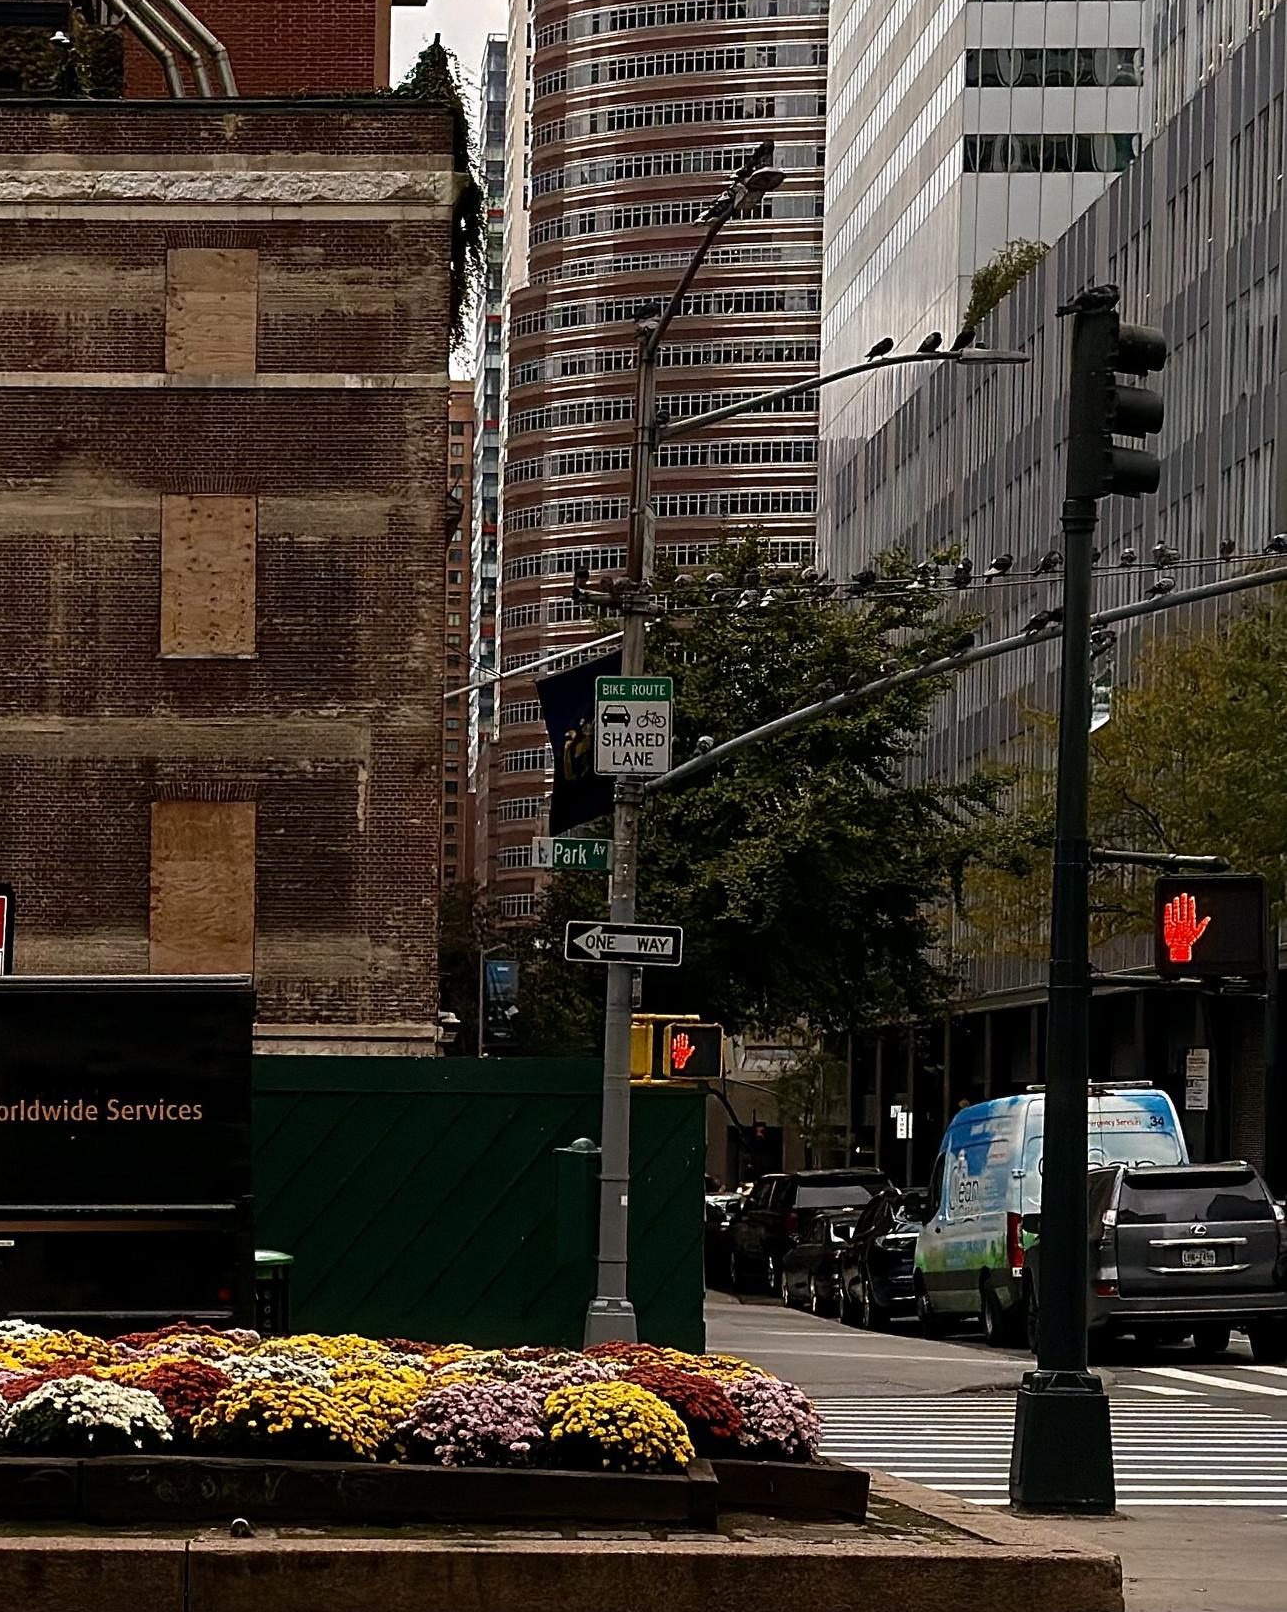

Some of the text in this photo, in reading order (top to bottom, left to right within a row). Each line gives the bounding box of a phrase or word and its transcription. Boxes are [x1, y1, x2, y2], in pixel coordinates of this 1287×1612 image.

[601, 682, 666, 697] BIKE ROUTE
[601, 732, 666, 748] SHARED
[612, 751, 654, 766] LANE
[553, 841, 607, 866] Park Av
[585, 934, 670, 953] ONE WAY
[106, 1099, 204, 1122] Services
[1149, 1115, 1166, 1127] 34
